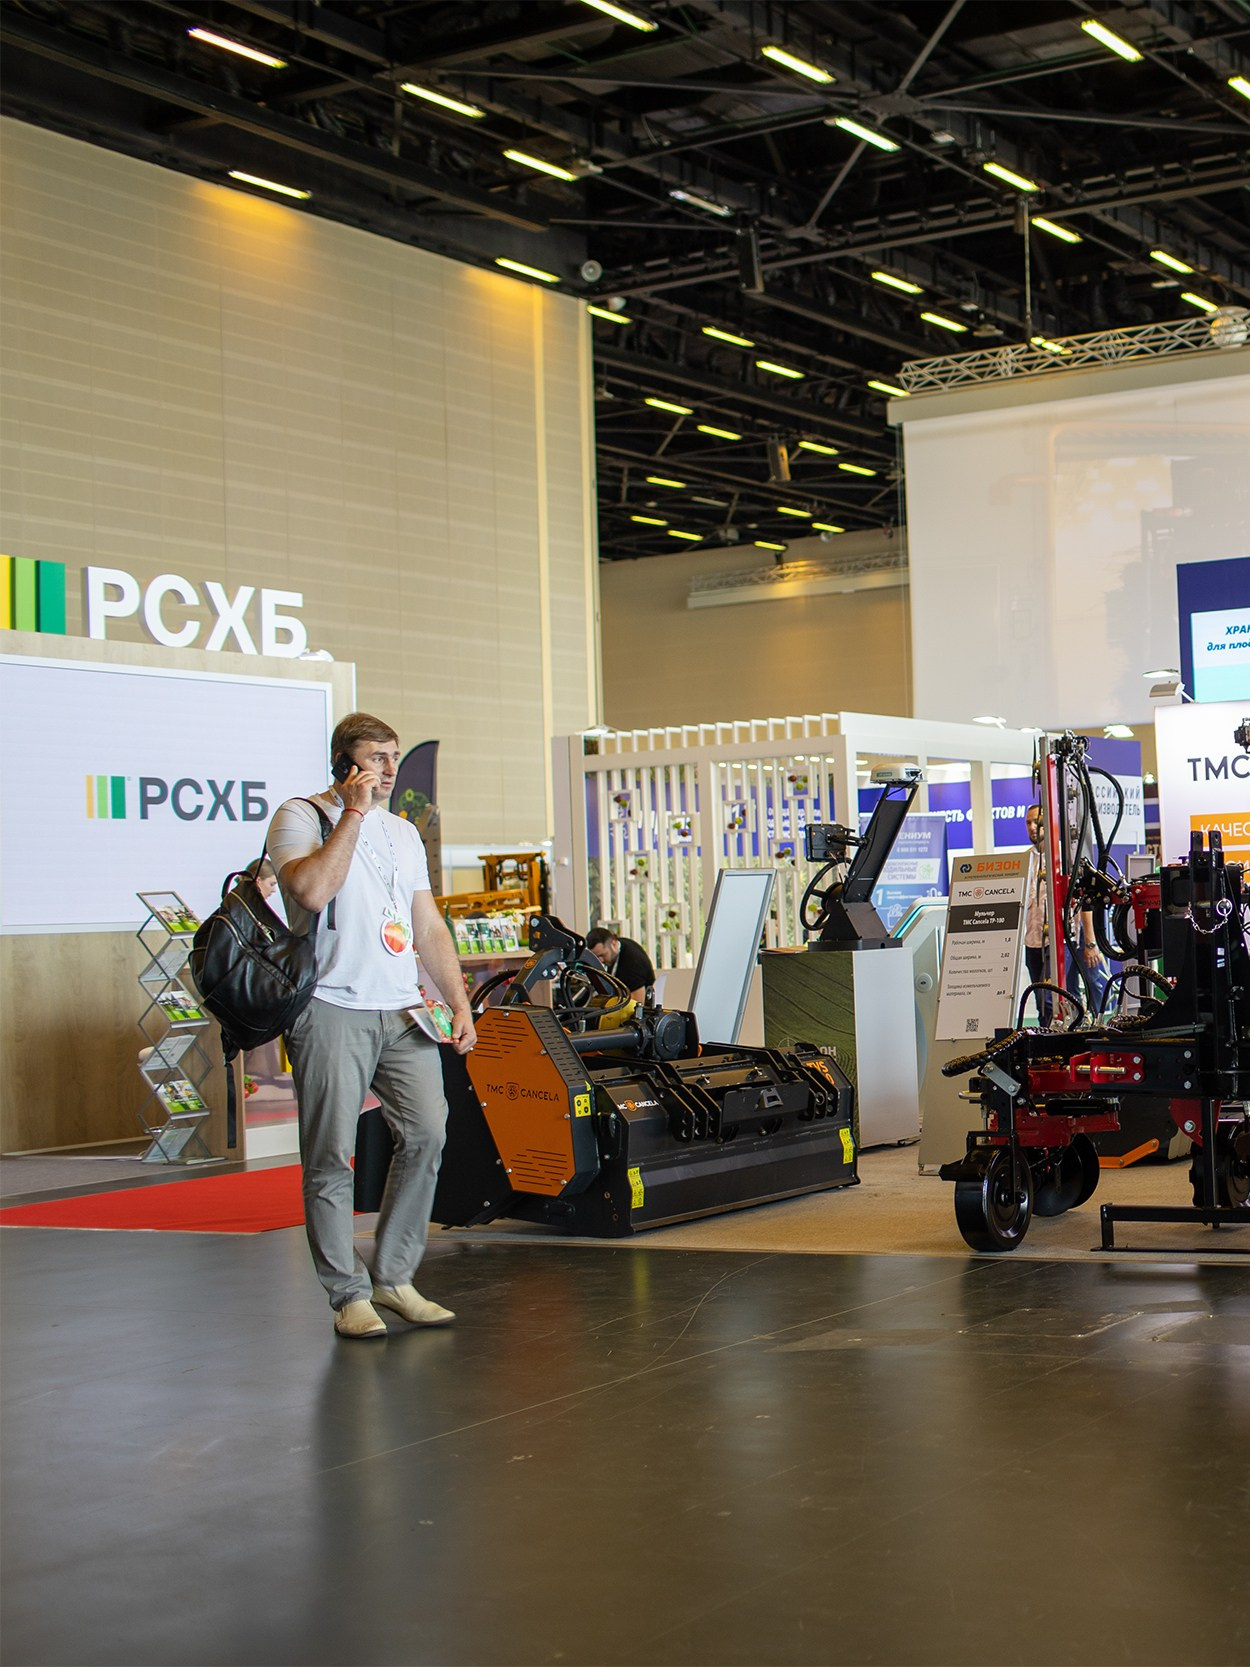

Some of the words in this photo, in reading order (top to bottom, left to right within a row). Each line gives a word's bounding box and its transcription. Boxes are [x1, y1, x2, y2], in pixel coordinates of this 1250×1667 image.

[86, 565, 309, 660] РСХБ
[1206, 642, 1226, 651] для
[138, 776, 269, 822] РСХБ
[976, 860, 1021, 872] БИЗОН
[958, 890, 972, 898] TMC
[984, 887, 1015, 896] CANCELA
[486, 1083, 504, 1095] TMC
[520, 1088, 560, 1102] CANCELA
